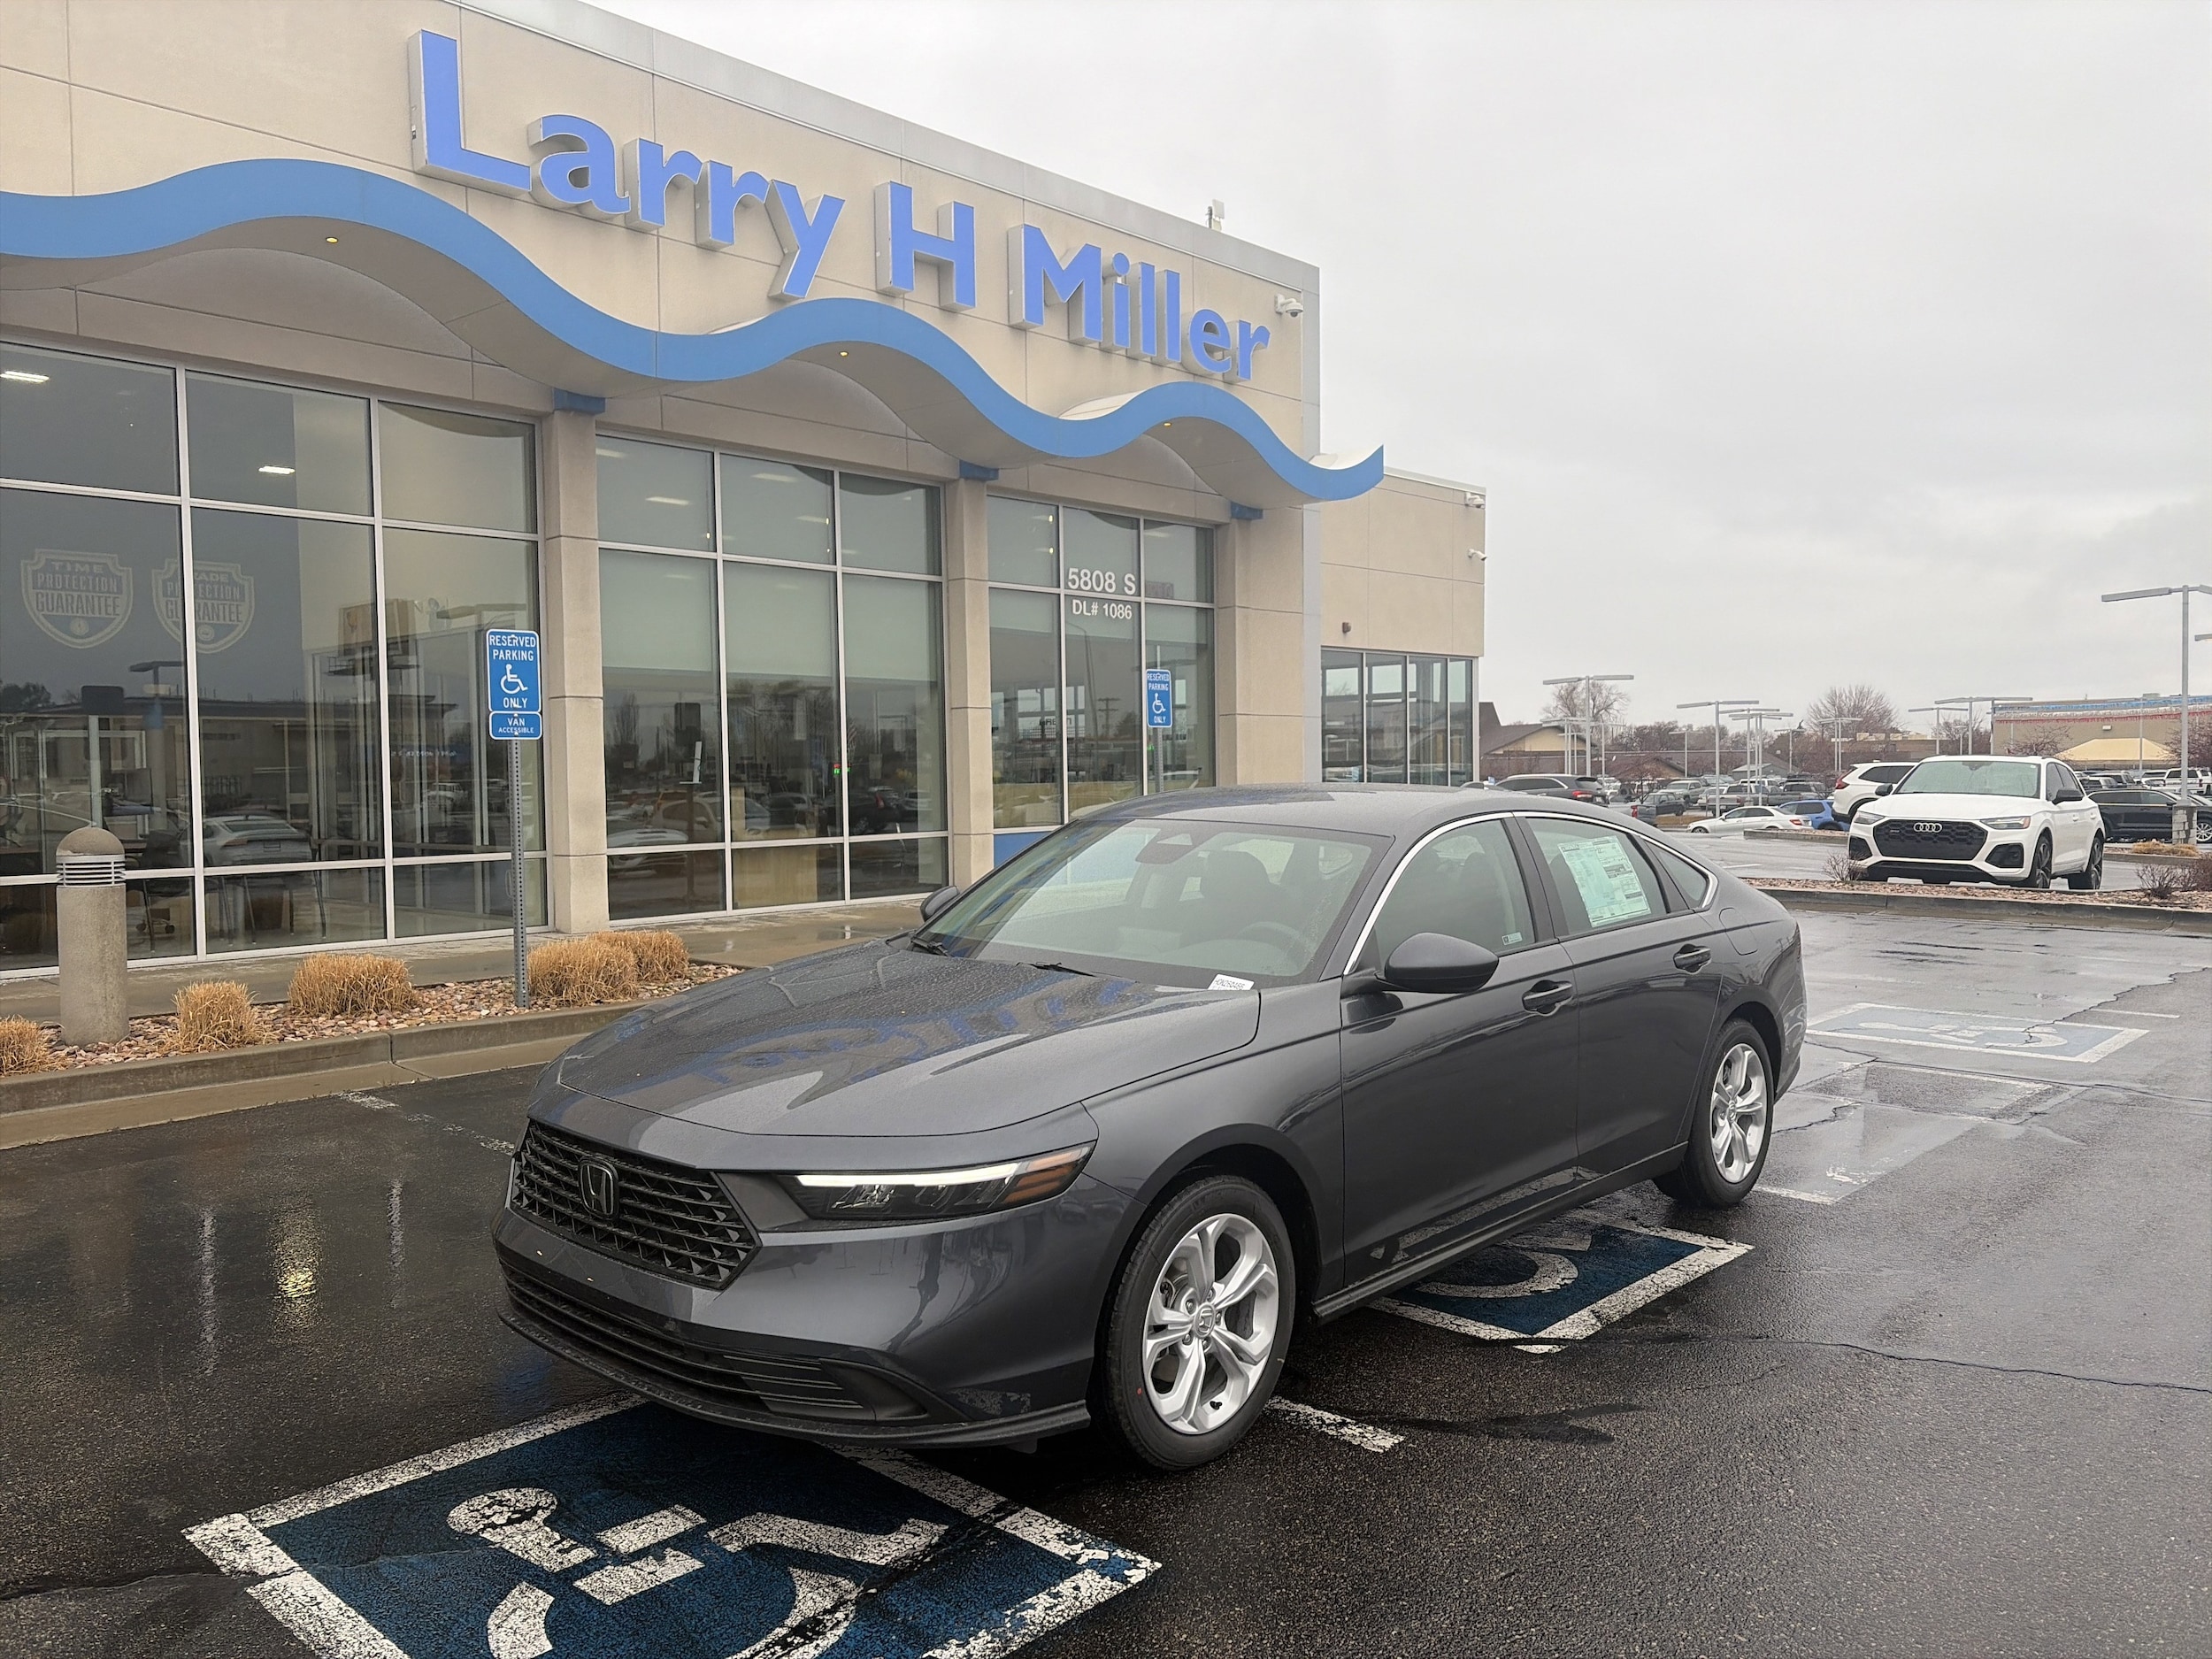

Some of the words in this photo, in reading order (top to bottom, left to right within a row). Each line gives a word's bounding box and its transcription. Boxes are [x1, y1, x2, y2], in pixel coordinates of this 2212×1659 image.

[416, 29, 845, 298] Larry
[883, 181, 976, 311] H
[1016, 224, 1271, 381] Miller
[51, 562, 104, 573] TIME
[37, 573, 118, 593] PROTECTION
[1068, 567, 1116, 593] 5808
[1124, 573, 1136, 595] S
[35, 591, 120, 616] GUARANTEE
[1072, 599, 1098, 616] DL#
[1102, 603, 1133, 619] 1086
[489, 634, 536, 648] RESERVED
[493, 649, 534, 662] PARKING
[1147, 672, 1170, 681] RESERVED
[1148, 682, 1169, 691] PARKING
[503, 697, 528, 709] ONLY
[507, 717, 526, 726] VAN
[1153, 715, 1166, 724] ONLY
